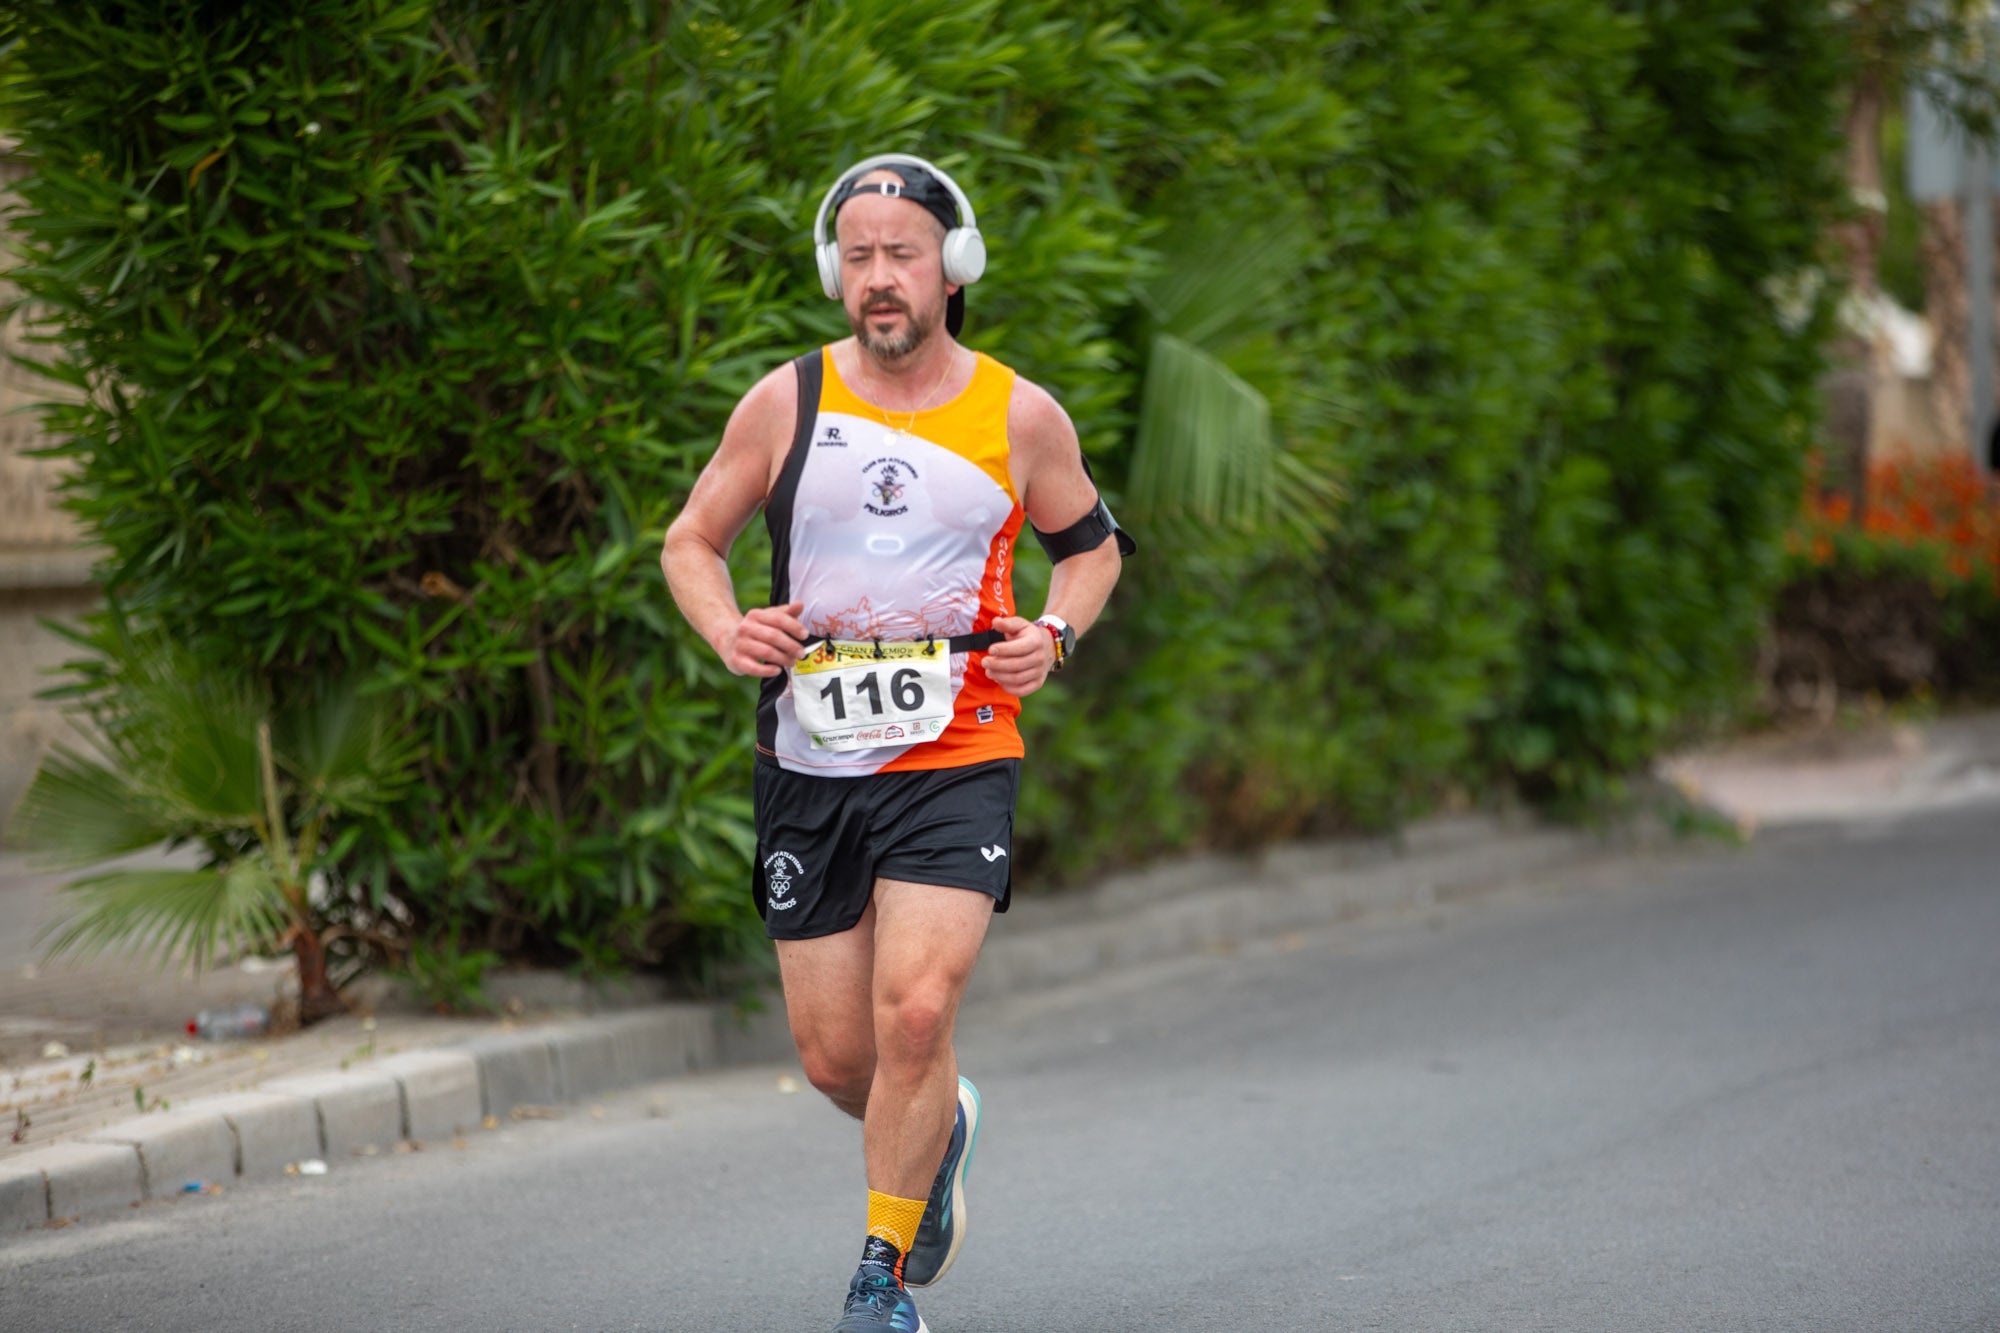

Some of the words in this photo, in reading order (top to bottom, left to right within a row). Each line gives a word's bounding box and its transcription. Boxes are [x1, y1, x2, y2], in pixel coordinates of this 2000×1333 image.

[888, 457, 918, 479] ATLETISMO
[864, 503, 908, 517] PELIGROS
[869, 647, 907, 656] PEMIO
[820, 668, 925, 721] 116
